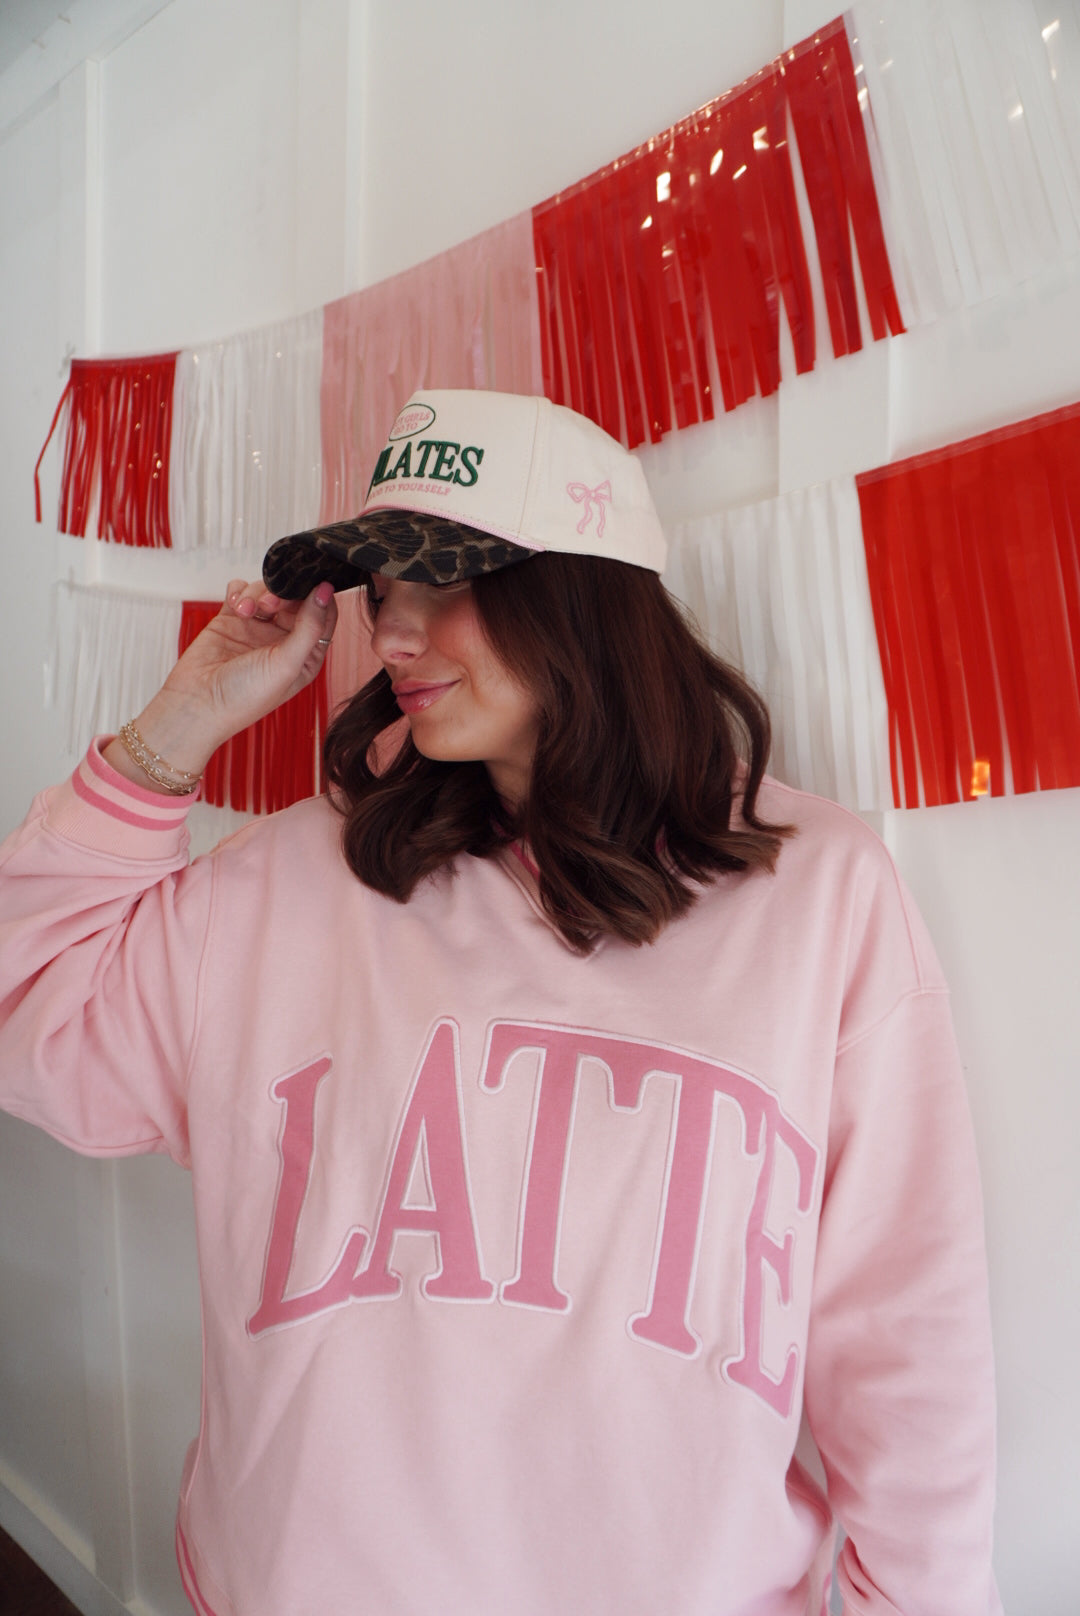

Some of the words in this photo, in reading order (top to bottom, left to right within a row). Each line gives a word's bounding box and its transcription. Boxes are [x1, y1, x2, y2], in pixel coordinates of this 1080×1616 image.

[406, 422, 418, 431] TO
[384, 484, 396, 494] TO
[398, 482, 451, 496] YOURSELF
[247, 1016, 821, 1420] LATTE
